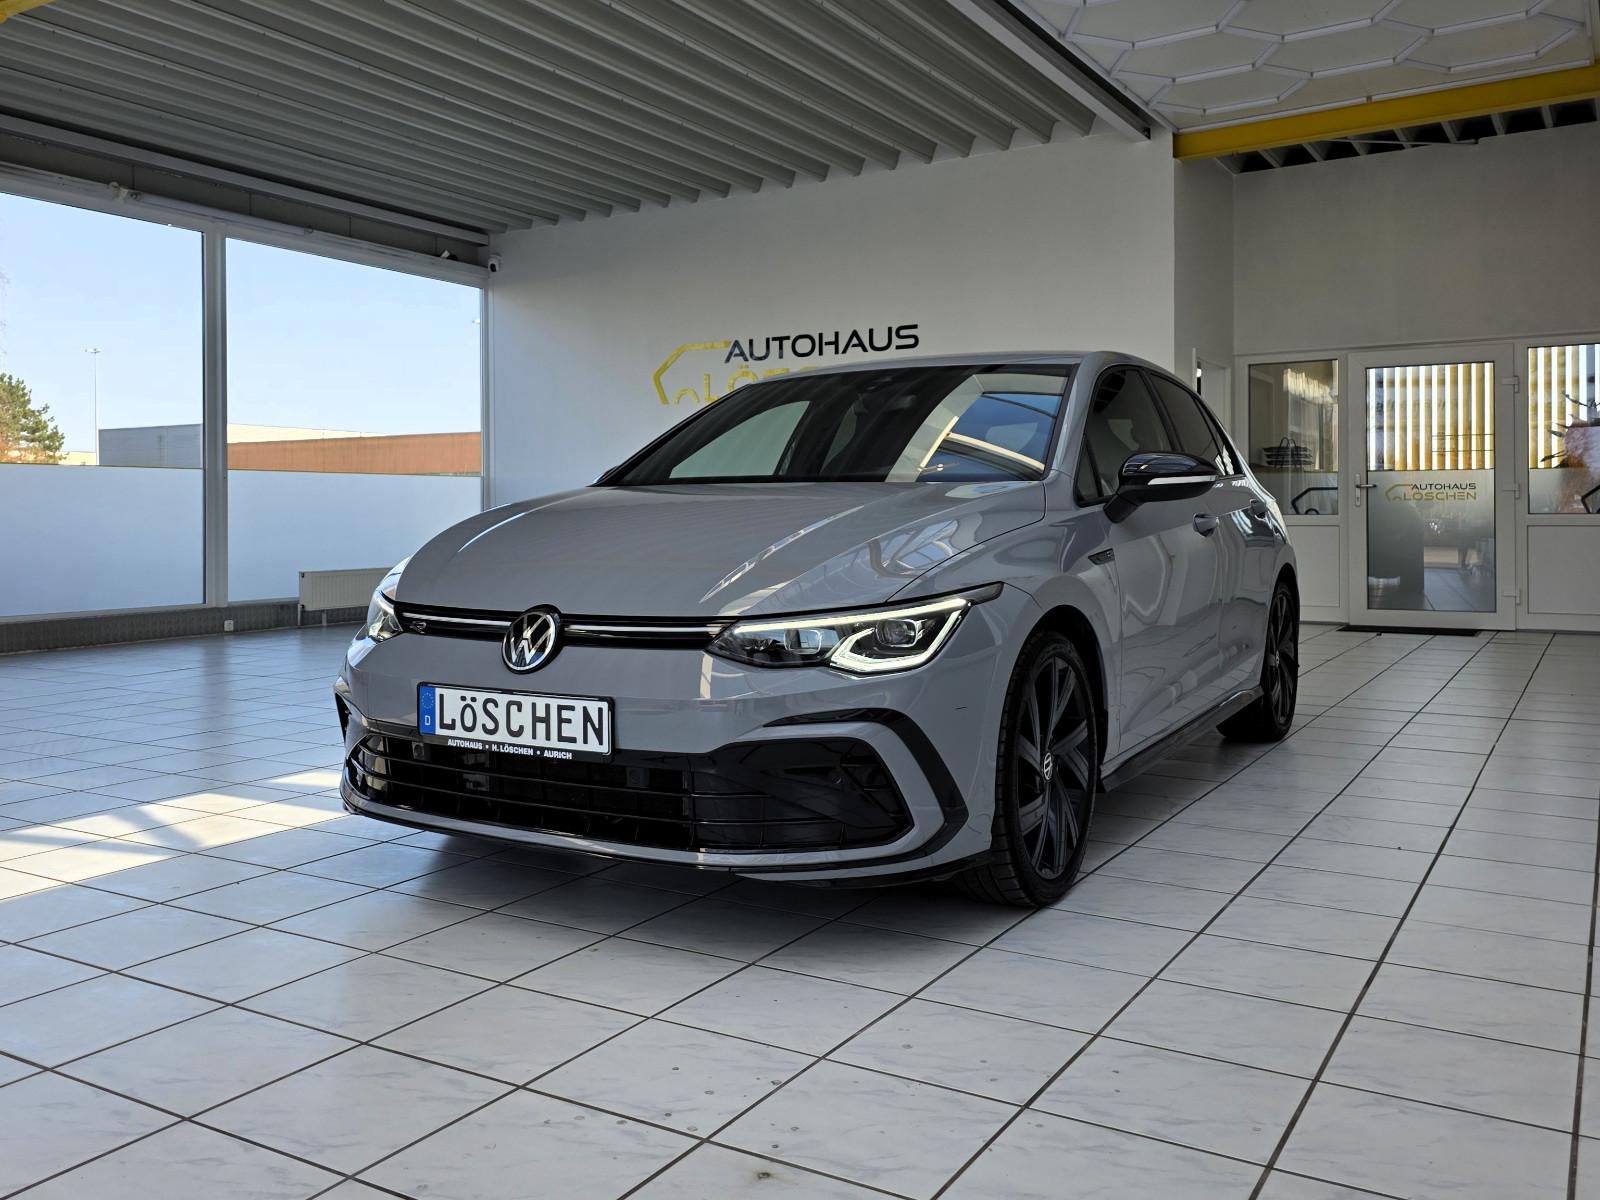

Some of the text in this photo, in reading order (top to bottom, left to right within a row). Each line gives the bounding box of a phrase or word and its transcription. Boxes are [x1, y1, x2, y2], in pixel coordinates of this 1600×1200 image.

[724, 324, 919, 363] AUTOHAUS
[1411, 483, 1477, 491] AUTOHAUS
[425, 715, 431, 726] D
[439, 694, 604, 746] LÖSCHEN
[447, 739, 483, 750] AUTOHAUS
[500, 744, 534, 756] LÖSCHEN
[543, 750, 573, 760] AURICH
